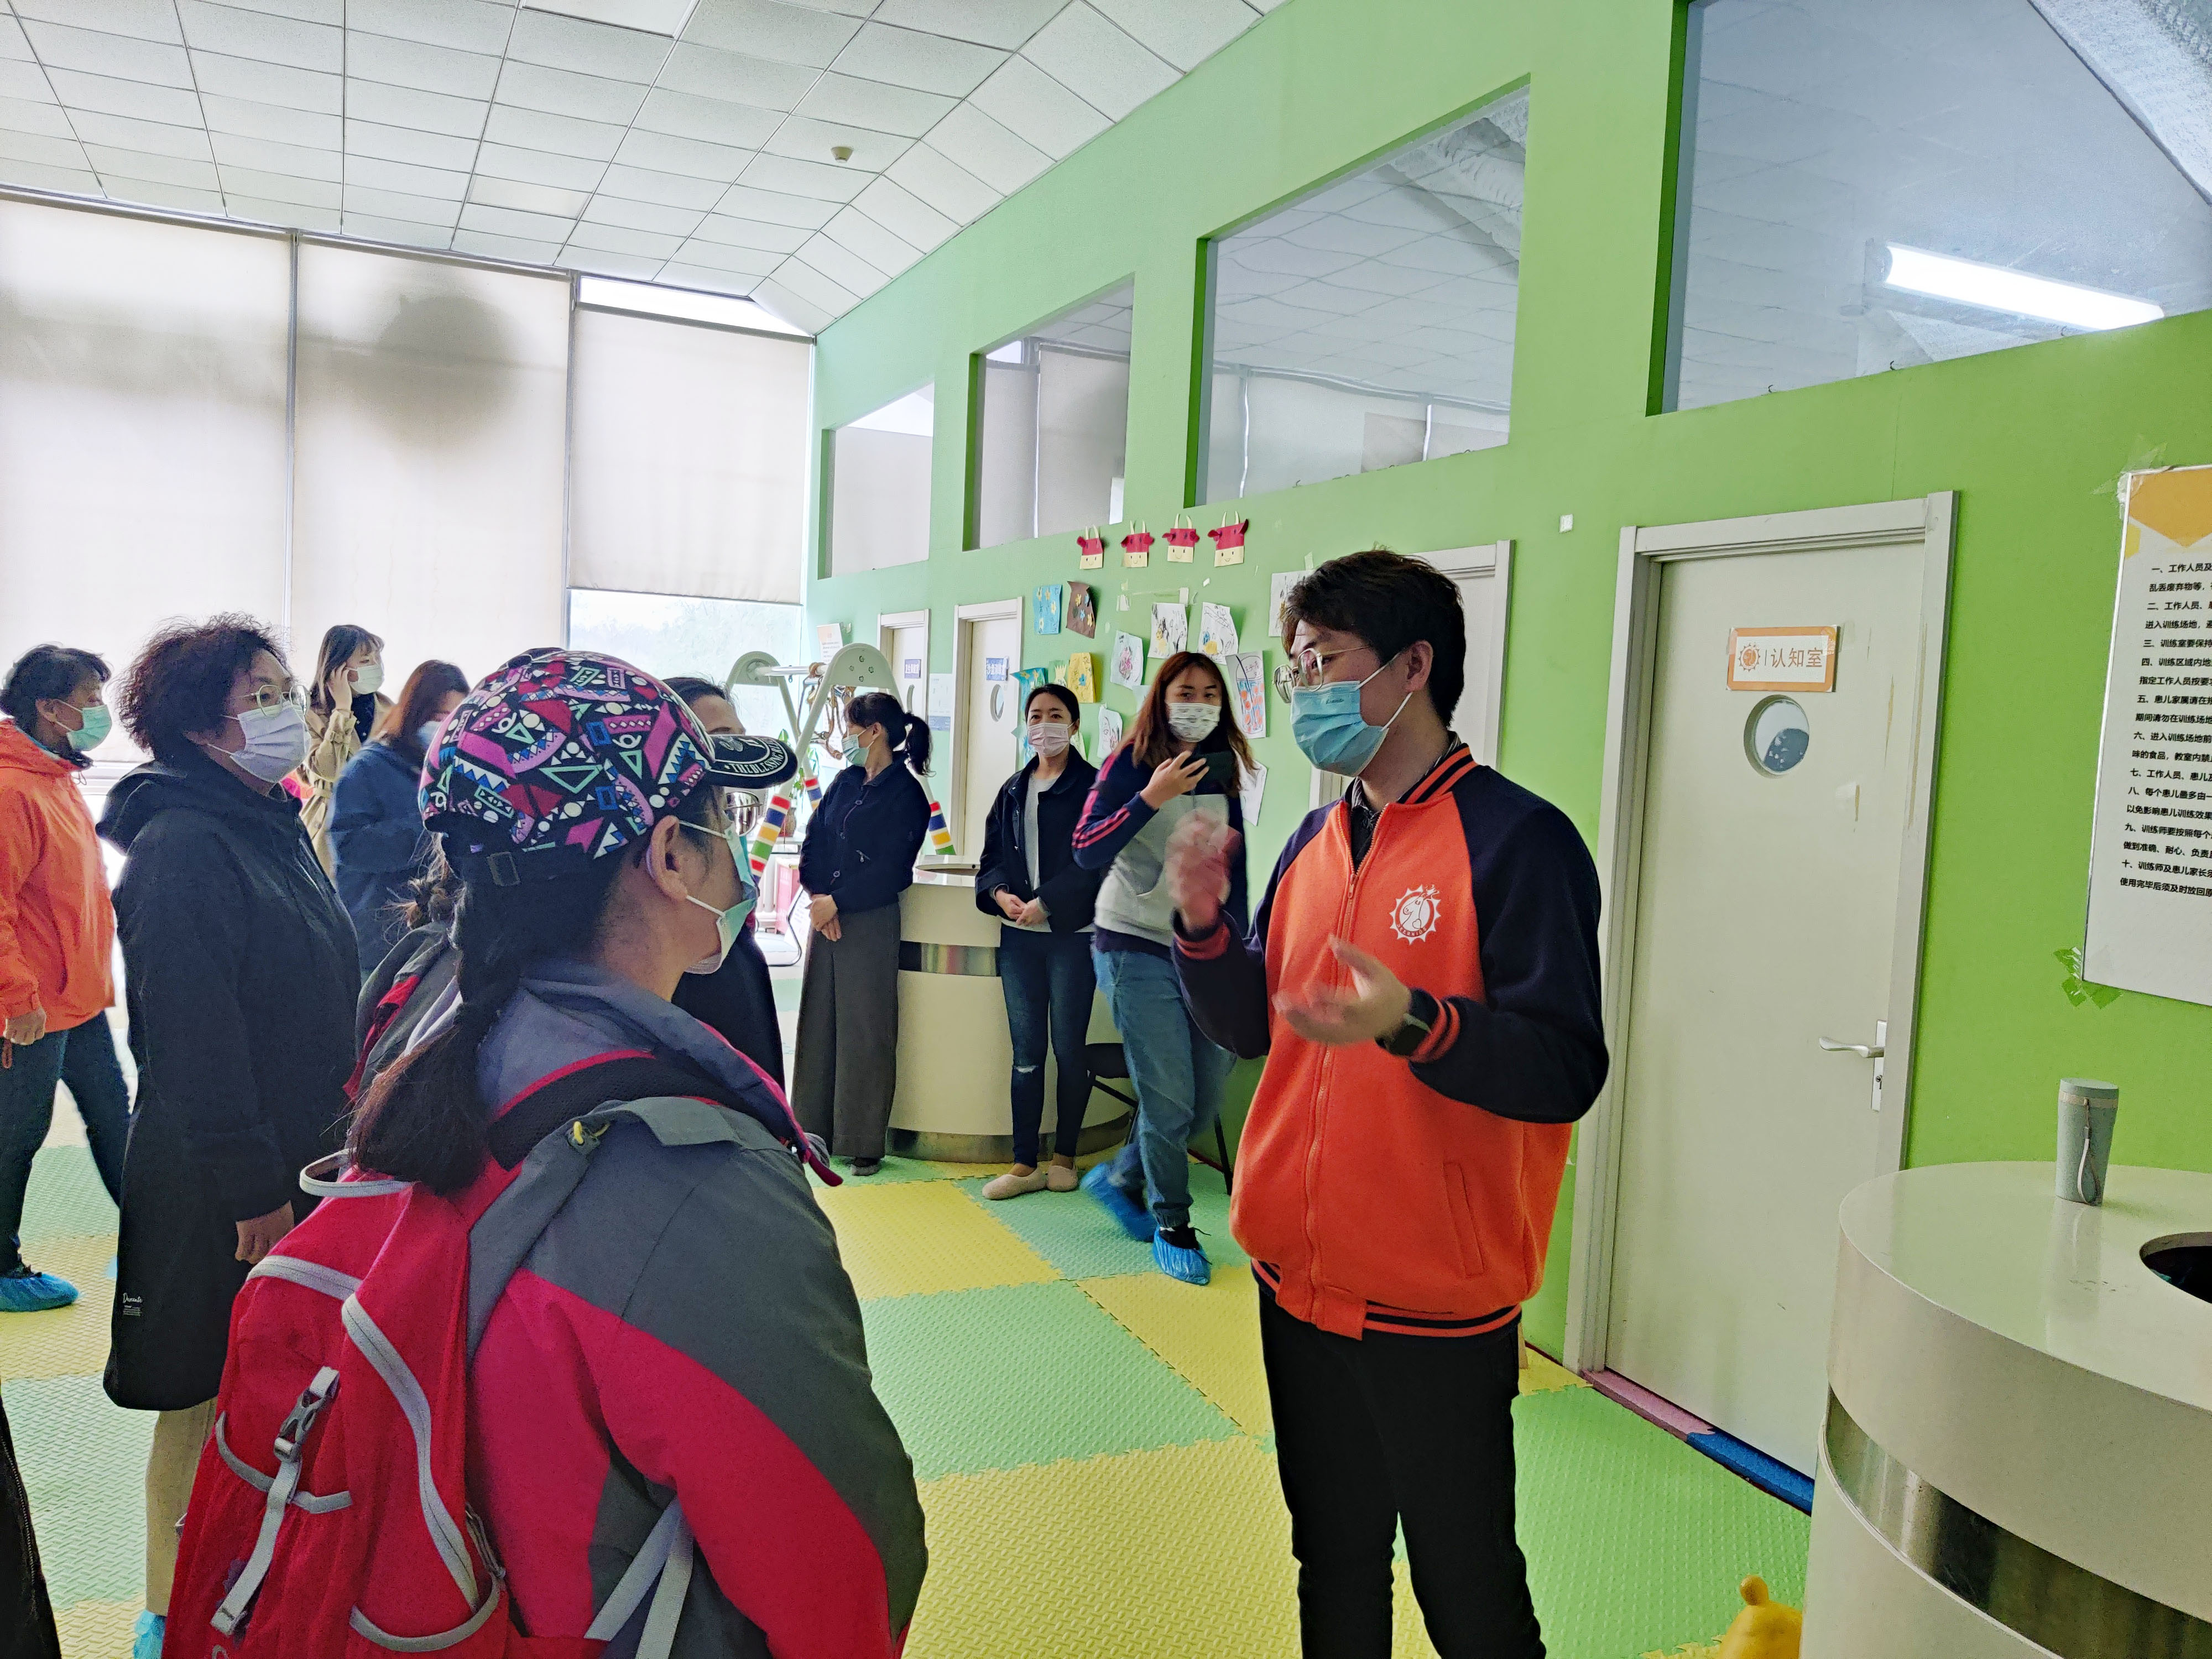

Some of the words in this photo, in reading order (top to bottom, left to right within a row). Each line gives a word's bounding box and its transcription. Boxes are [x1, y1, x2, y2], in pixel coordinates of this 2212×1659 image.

[2149, 582, 2212, 592] 乱丢废弃物等，
[1771, 648, 1823, 668] 认知室
[2141, 658, 2212, 667] 四、训练区域内地
[2125, 823, 2212, 839] 九、训练师要按照每个
